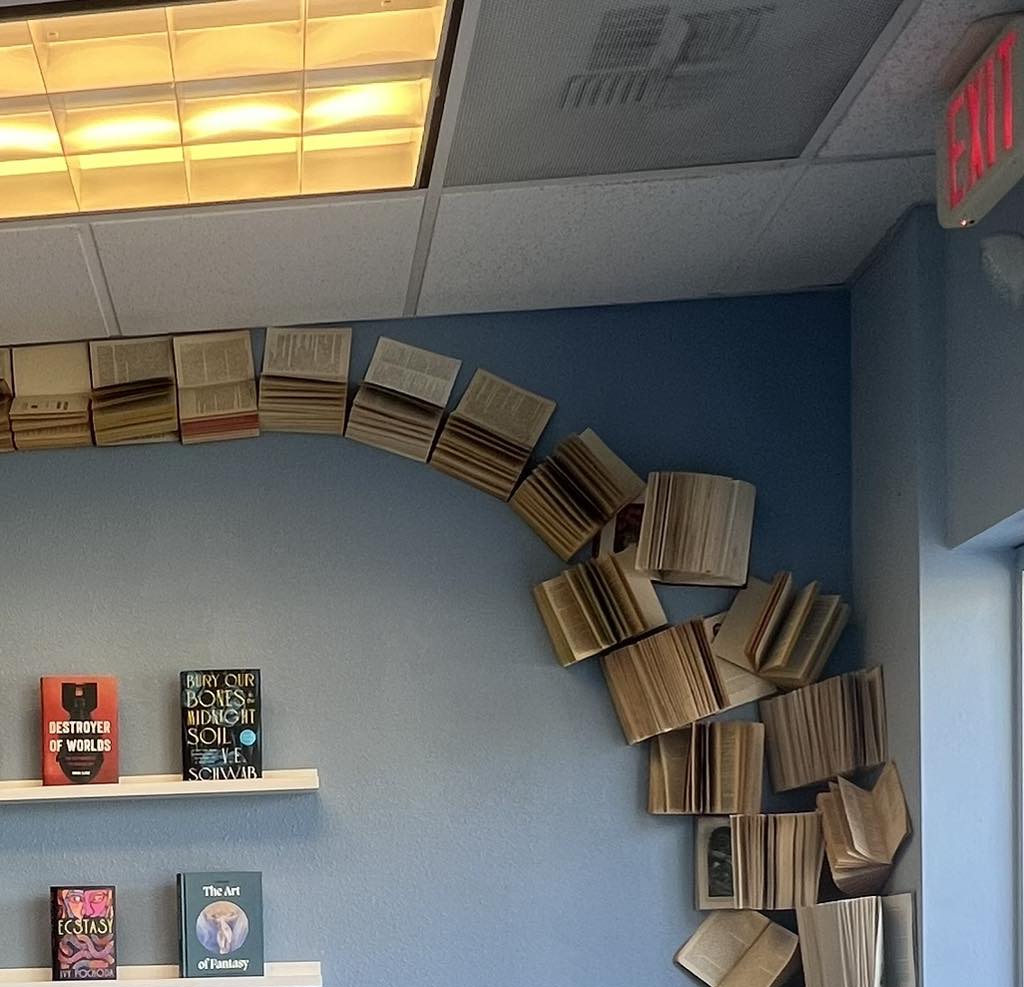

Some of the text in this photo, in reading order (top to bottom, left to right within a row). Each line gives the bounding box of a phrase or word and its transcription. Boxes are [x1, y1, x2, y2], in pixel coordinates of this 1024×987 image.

[946, 29, 1019, 211] EXIT
[187, 673, 255, 688] BURY OUR
[187, 689, 245, 708] BONES
[187, 708, 256, 726] MIDNIGHT
[49, 721, 111, 734] DESTROYER
[187, 727, 231, 745] SOIL
[49, 739, 112, 752] OF WORLDS
[189, 766, 257, 781] SCHWAB
[202, 885, 241, 897] The Art
[58, 918, 113, 936] ECSTASY
[198, 958, 249, 971] of Fantasy
